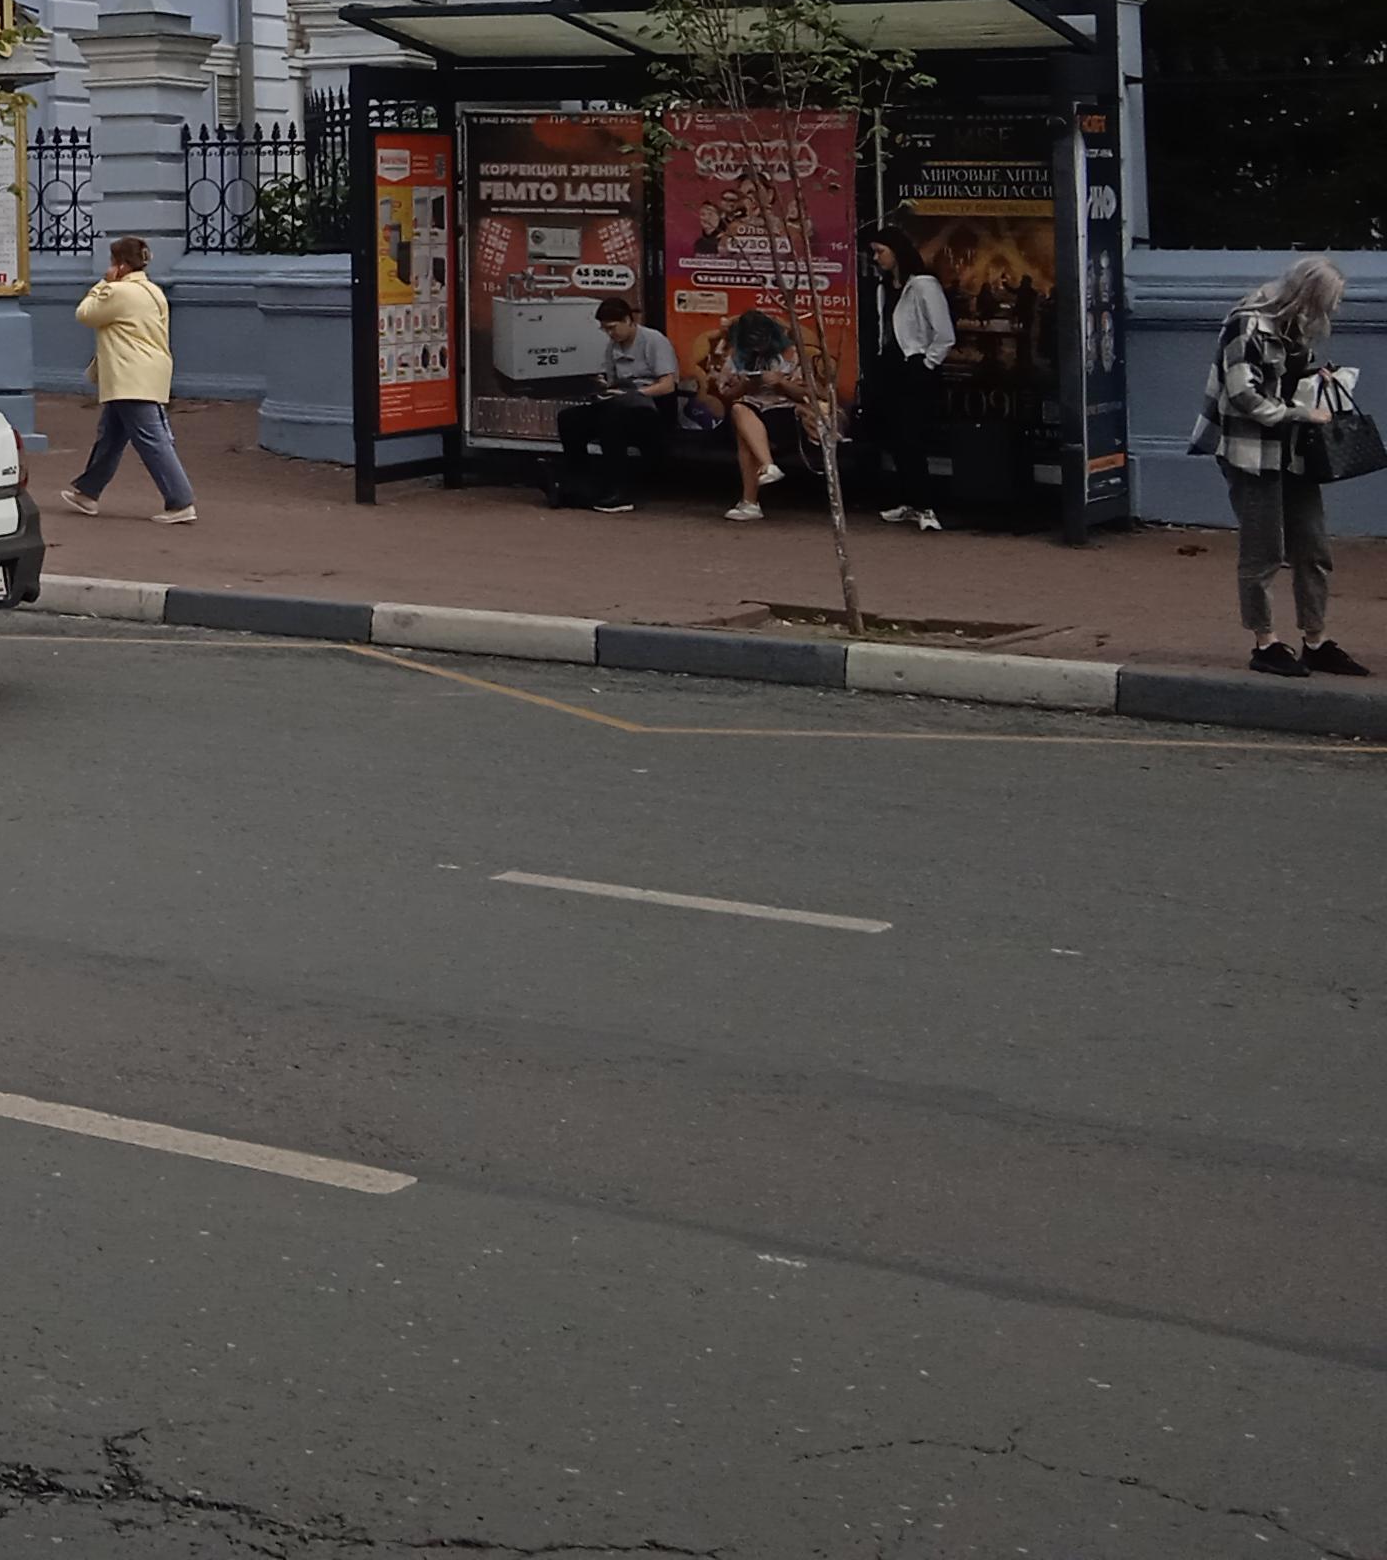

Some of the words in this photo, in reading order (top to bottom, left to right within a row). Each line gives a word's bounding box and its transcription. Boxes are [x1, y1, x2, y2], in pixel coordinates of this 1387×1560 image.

[670, 113, 693, 130] 17
[479, 163, 568, 178] КОРРЕКЦИЯ
[921, 167, 1003, 182] МИРОВЫЕ
[1005, 168, 1049, 183] ХИТЫ
[479, 181, 558, 201] FEMTO
[564, 182, 632, 203] LASIK
[898, 184, 909, 197] И
[913, 184, 983, 198] ВЕЛИКАЯ
[987, 184, 1053, 199] КЛАССИ
[755, 294, 772, 305] 24
